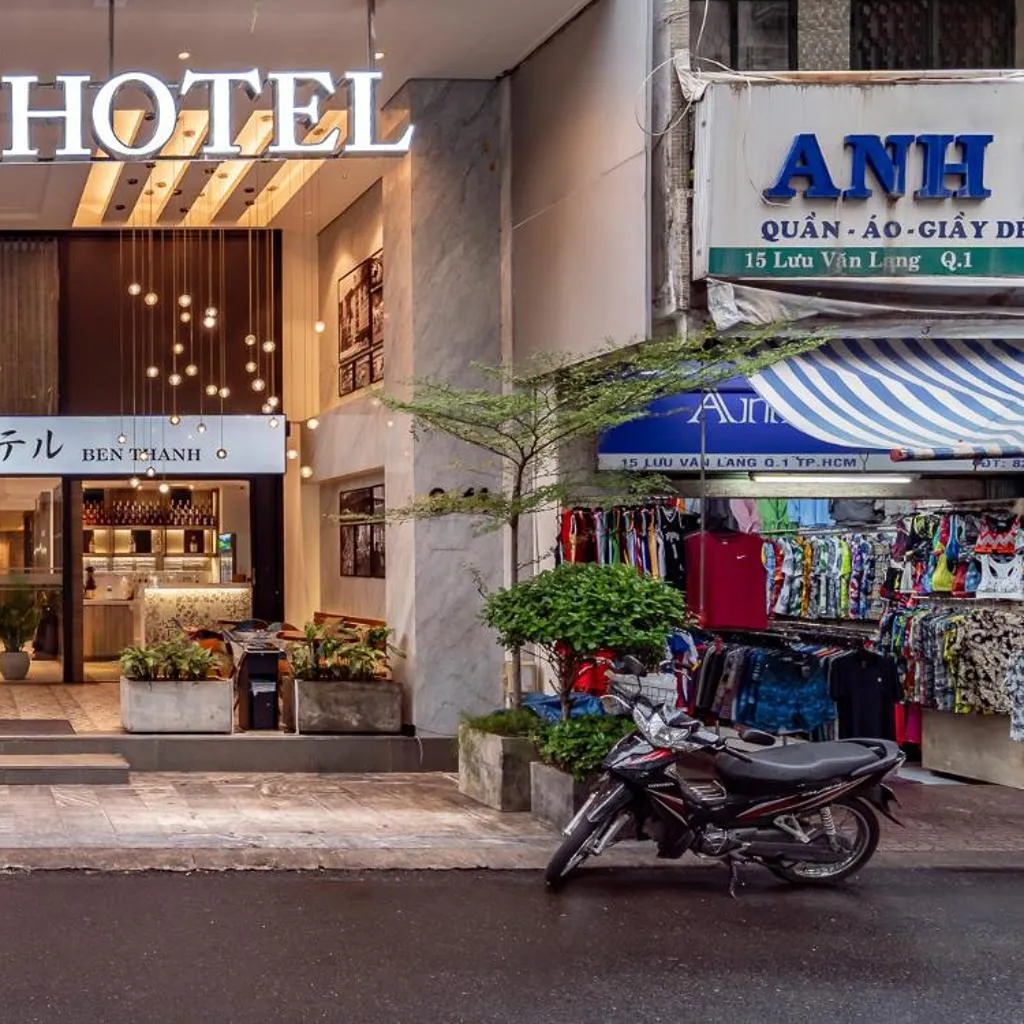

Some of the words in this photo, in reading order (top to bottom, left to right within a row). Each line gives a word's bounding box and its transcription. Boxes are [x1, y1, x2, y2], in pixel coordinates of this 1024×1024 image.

[1, 69, 416, 162] HOTEL
[762, 133, 994, 200] ANH
[761, 212, 841, 242] QUẦN
[745, 252, 767, 269] 15
[773, 251, 814, 269] Lưu
[940, 250, 973, 271] Q.1
[687, 389, 788, 424] An
[81, 448, 124, 462] BEN
[128, 447, 201, 462] THANH
[622, 458, 638, 468] 15
